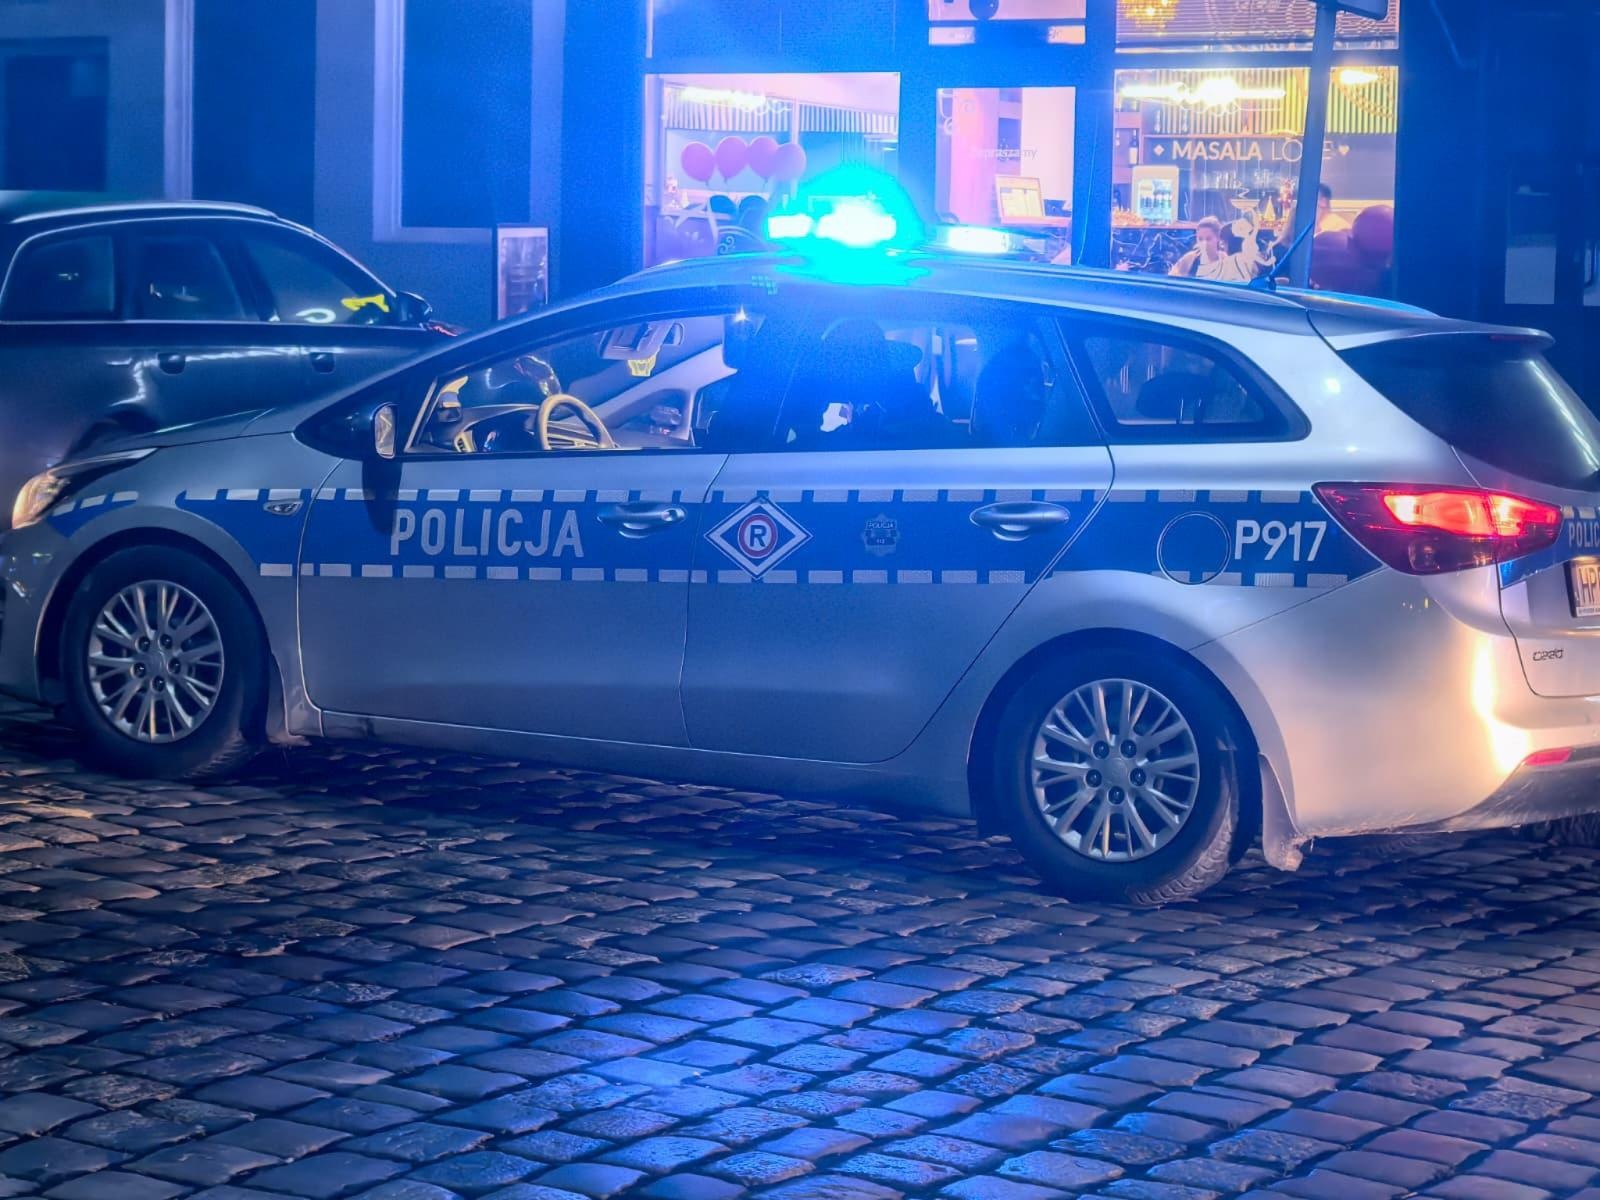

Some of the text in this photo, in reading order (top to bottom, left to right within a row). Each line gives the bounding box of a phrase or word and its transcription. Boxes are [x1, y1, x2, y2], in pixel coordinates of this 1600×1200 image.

[1172, 139, 1334, 162] MASALA LOE
[390, 508, 584, 558] POLICJA
[749, 524, 766, 547] R
[1234, 519, 1327, 562] P917
